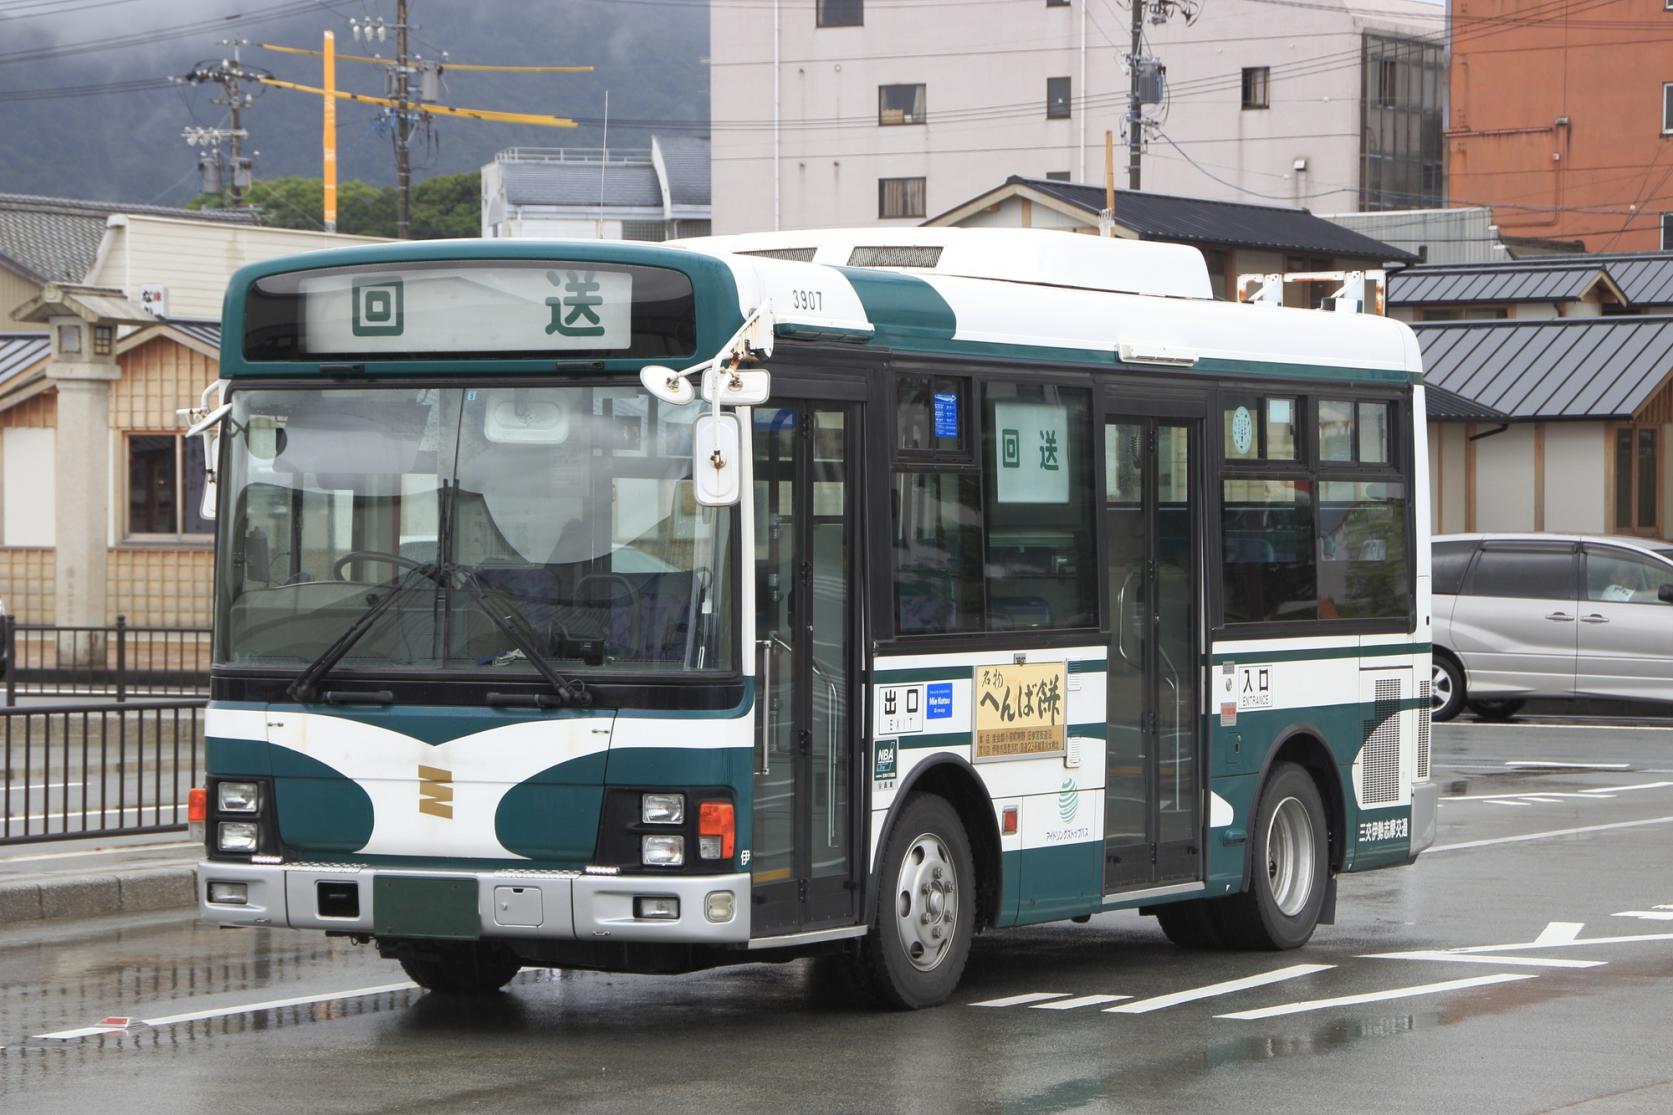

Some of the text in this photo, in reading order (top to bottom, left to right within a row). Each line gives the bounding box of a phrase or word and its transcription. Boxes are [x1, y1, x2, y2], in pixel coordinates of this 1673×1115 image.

[352, 270, 605, 337] 回送
[792, 289, 822, 311] 3907
[1002, 428, 1059, 471] 回送
[981, 668, 1004, 688] 名物
[1243, 668, 1269, 693] 入口
[884, 688, 919, 715] 出口
[980, 673, 1061, 726] へんば餅
[1242, 694, 1269, 707] ENTRANCE
[890, 717, 912, 731] EXIT
[877, 748, 894, 762] NBA
